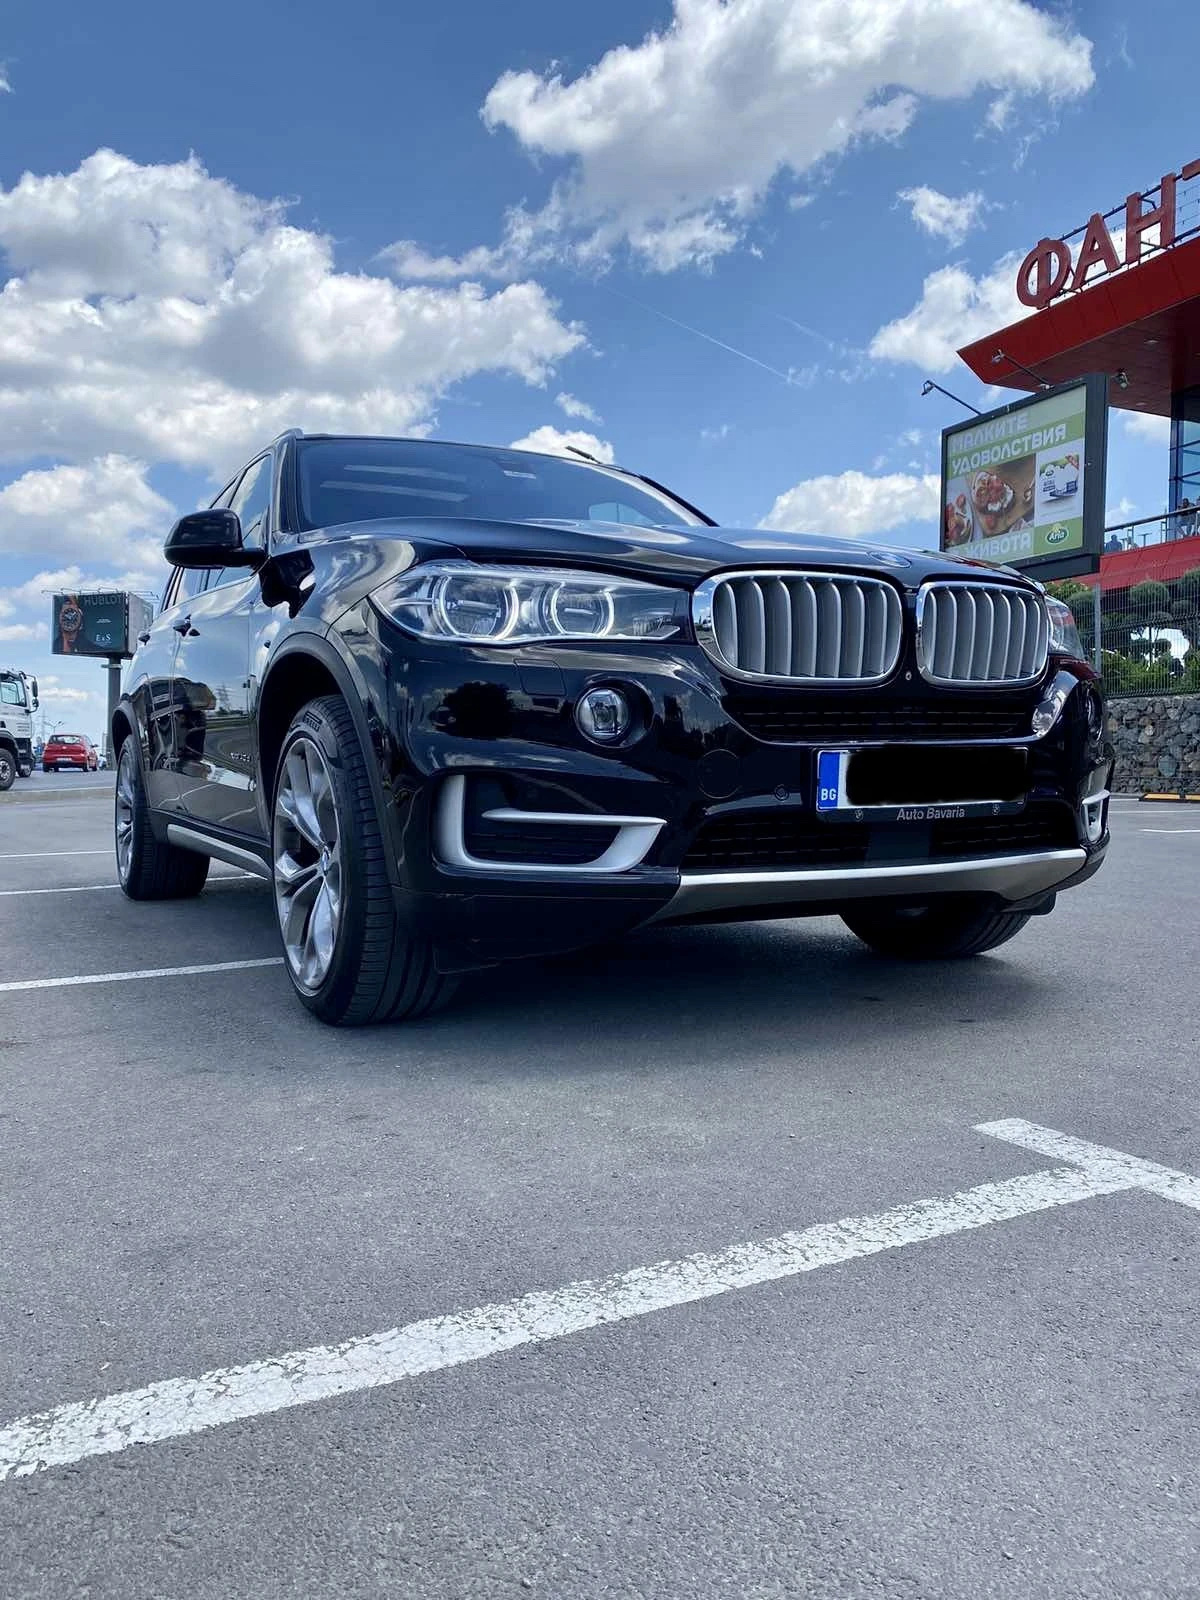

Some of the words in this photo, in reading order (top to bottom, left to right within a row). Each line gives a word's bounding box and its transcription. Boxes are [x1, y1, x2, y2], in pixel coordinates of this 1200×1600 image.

[952, 424, 1066, 475] УДОВОЛСТВИЯ
[83, 594, 122, 607] HUBLOT
[820, 788, 837, 801] BG
[896, 808, 924, 821] Auto
[926, 806, 965, 820] Bavaria
